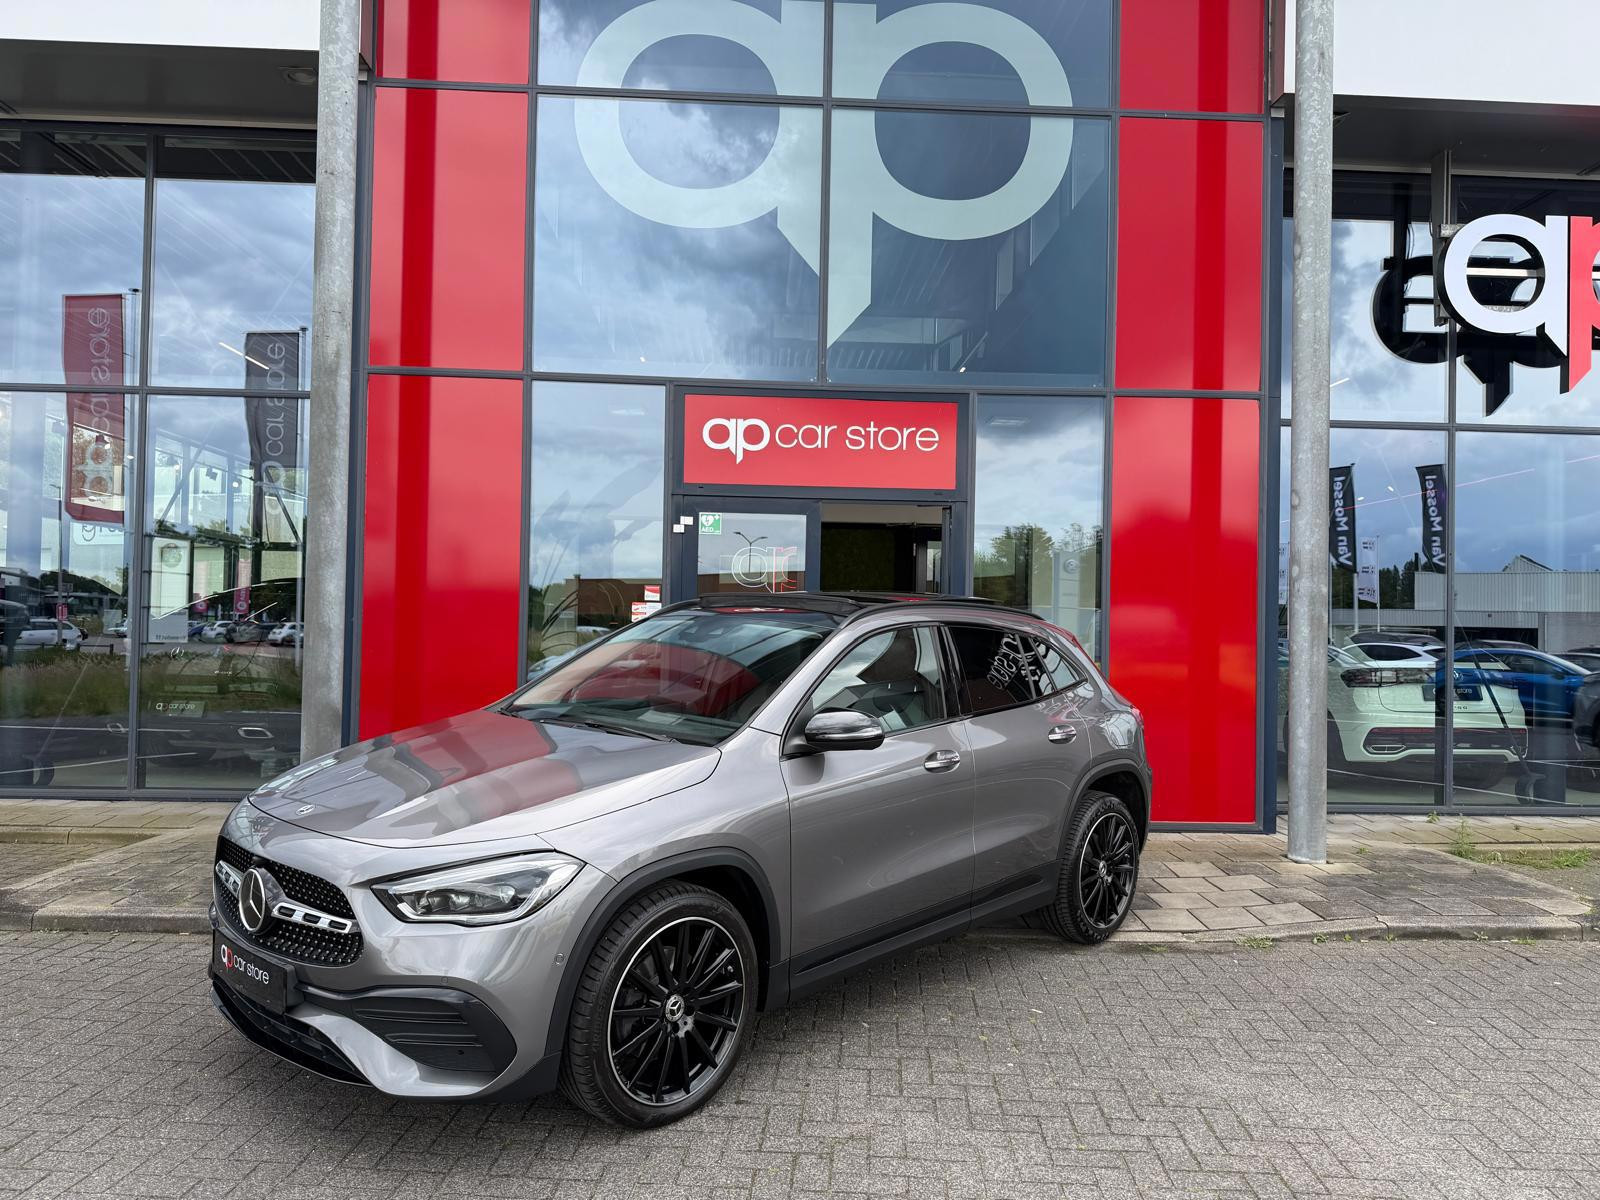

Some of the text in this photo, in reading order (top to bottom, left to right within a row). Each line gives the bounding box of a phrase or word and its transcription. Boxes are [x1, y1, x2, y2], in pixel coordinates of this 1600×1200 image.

[574, 0, 1073, 349] ap
[702, 417, 939, 464] ap car store
[220, 944, 270, 985] ap car store
